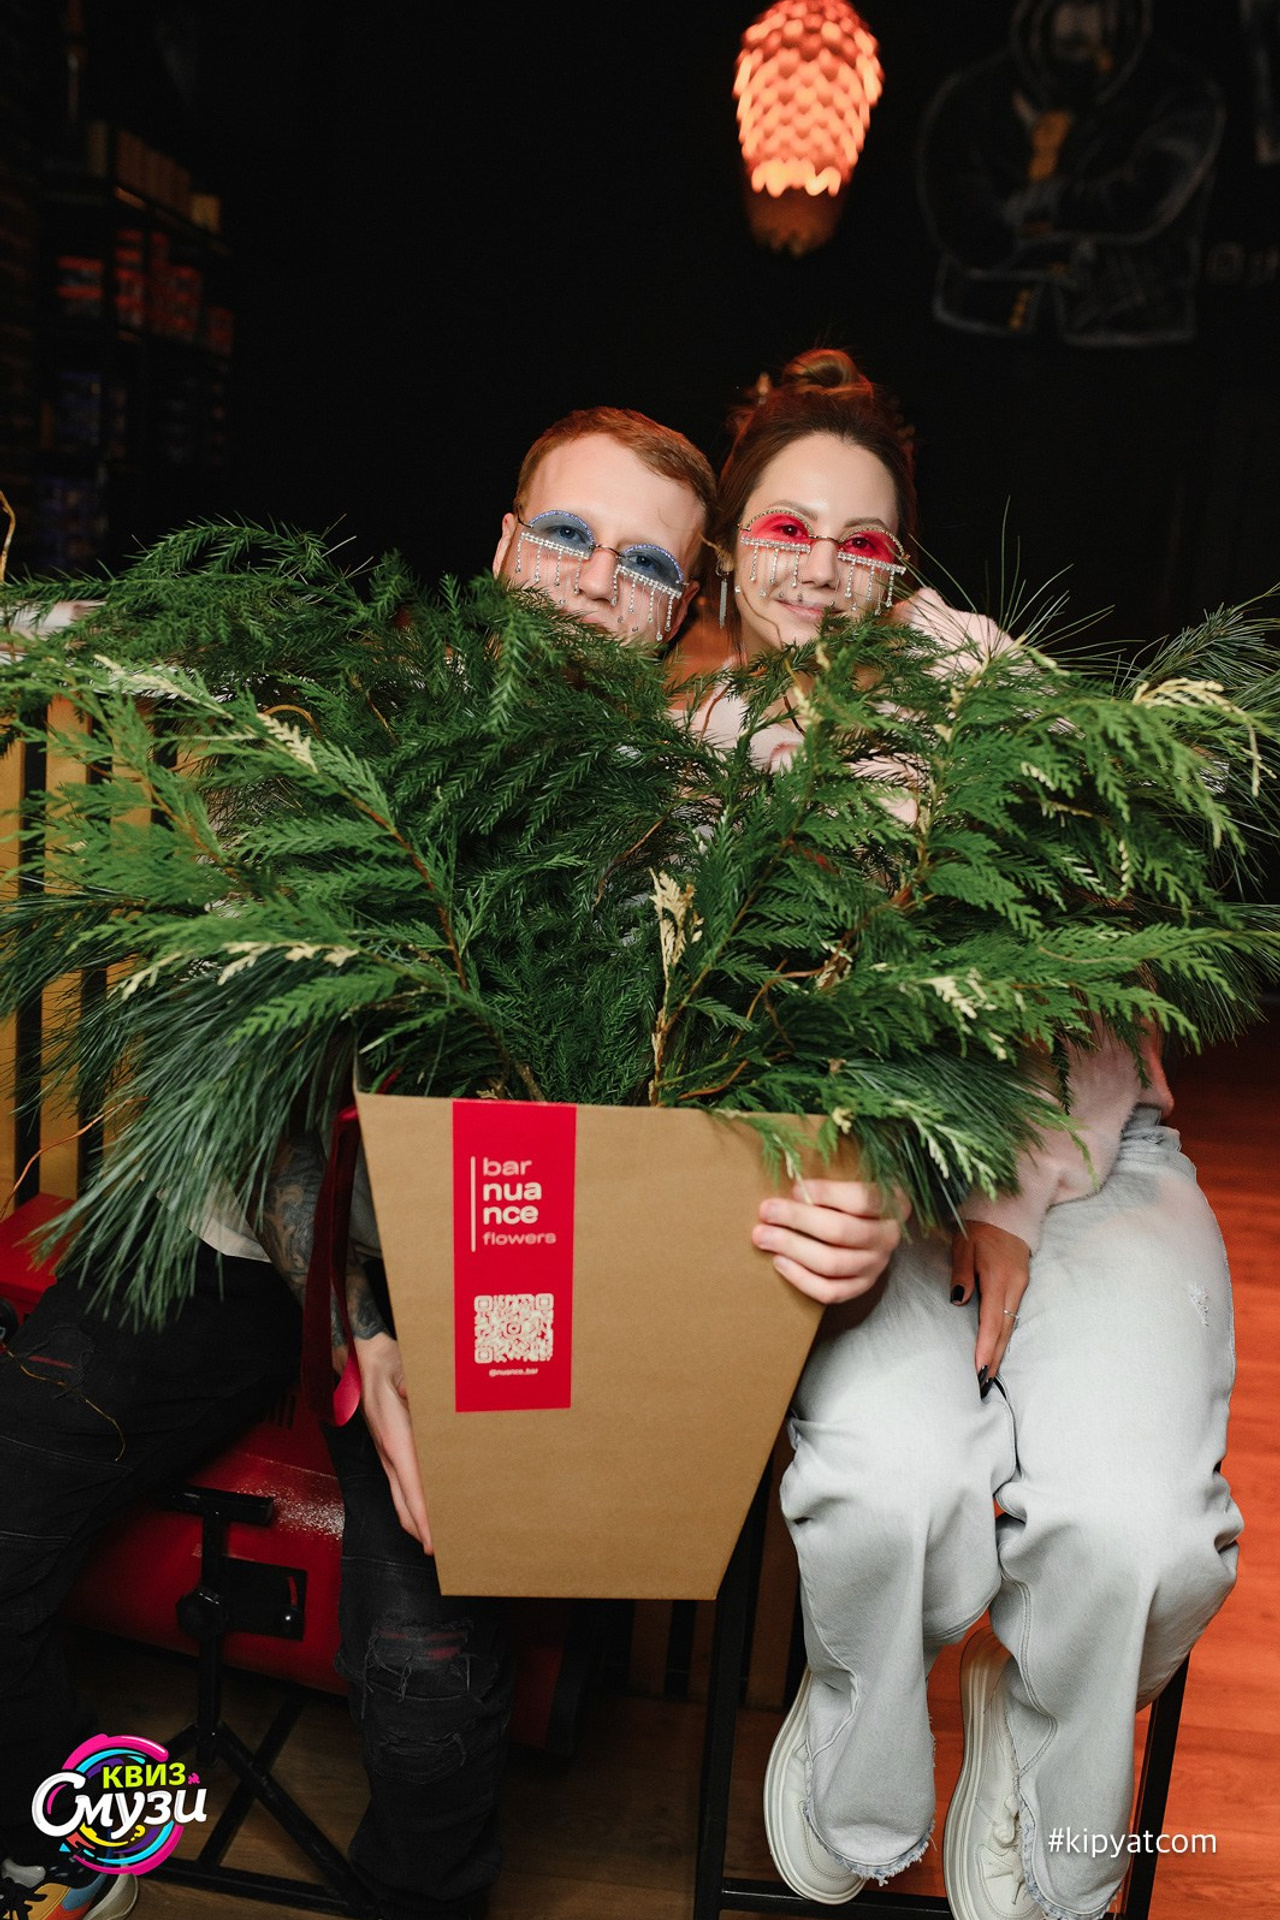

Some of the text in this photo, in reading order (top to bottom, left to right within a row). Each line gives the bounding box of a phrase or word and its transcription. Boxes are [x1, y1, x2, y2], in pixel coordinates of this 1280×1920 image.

[482, 1157, 532, 1177] bar
[483, 1181, 542, 1202] nua
[483, 1206, 539, 1225] nce
[483, 1232, 557, 1246] flowers
